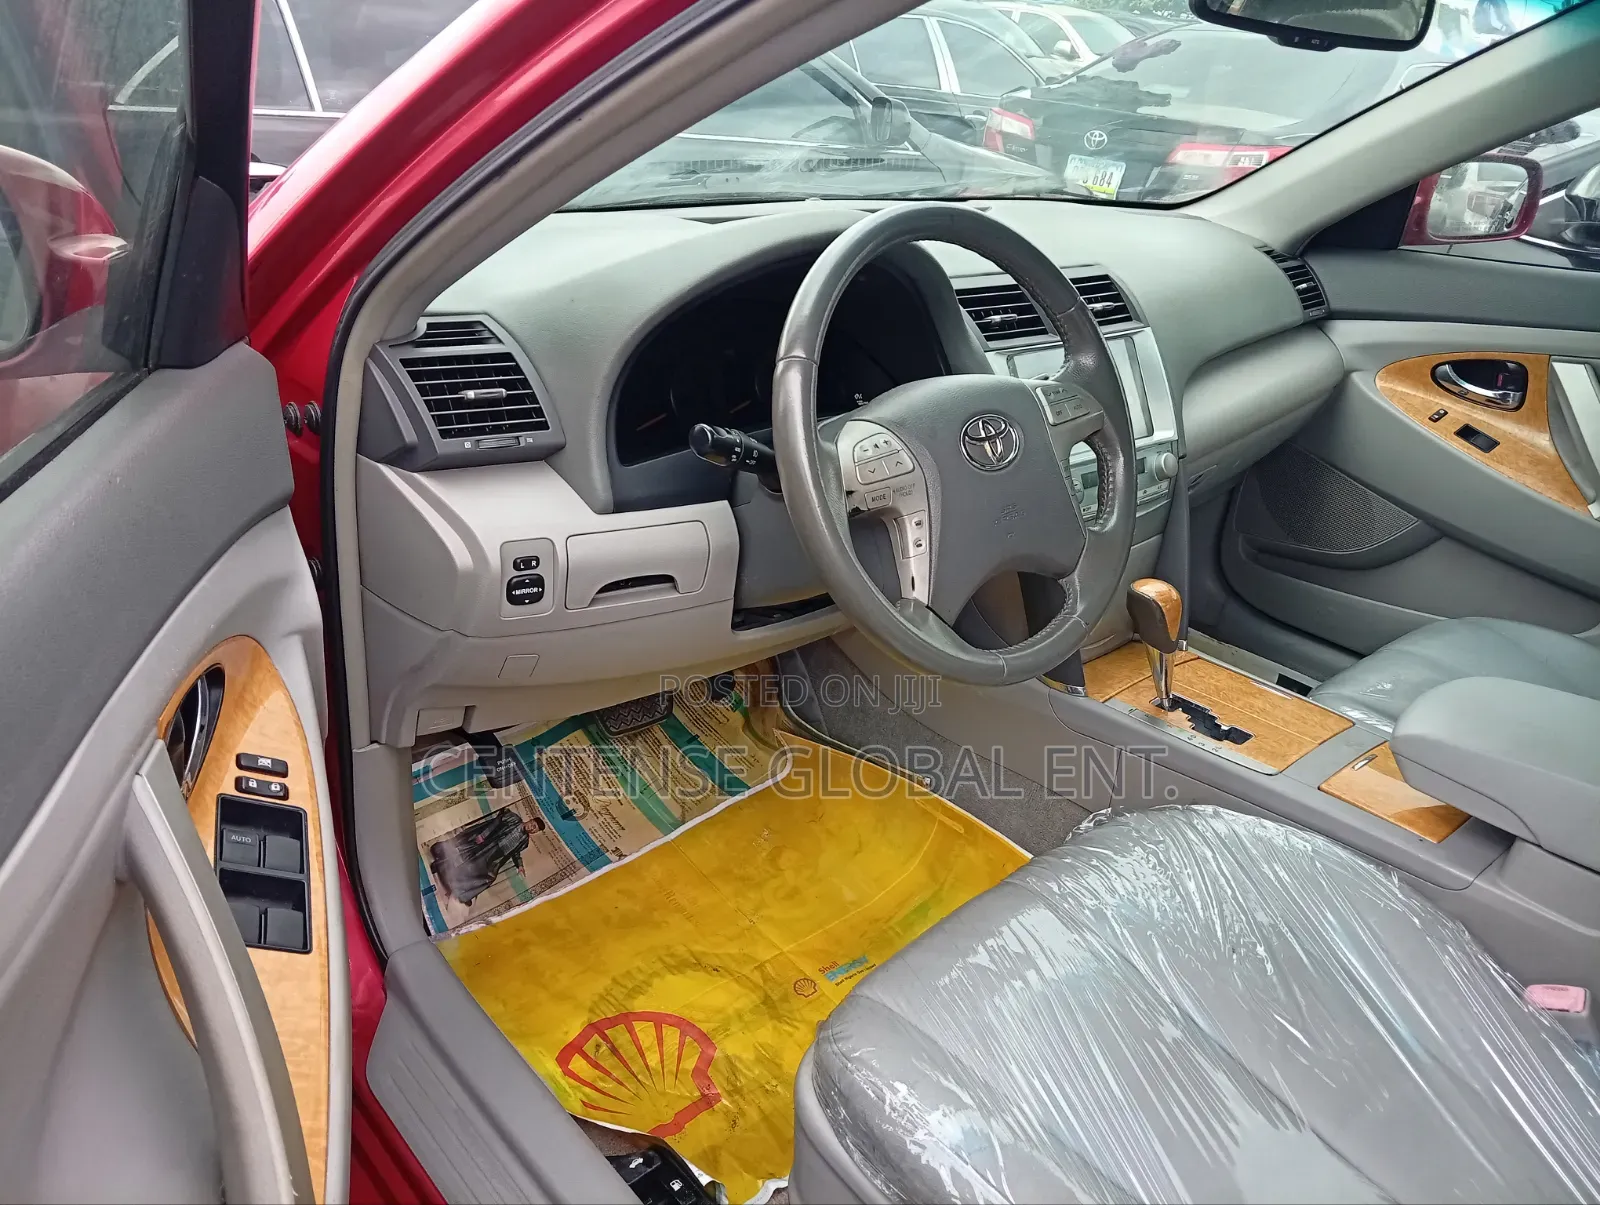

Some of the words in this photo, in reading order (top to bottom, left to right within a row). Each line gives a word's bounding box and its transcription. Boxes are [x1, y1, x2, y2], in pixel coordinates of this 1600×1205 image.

[871, 493, 887, 502] MODE
[515, 587, 539, 595] MIRROR
[231, 834, 252, 843] AUTO
[818, 961, 840, 975] Shell
